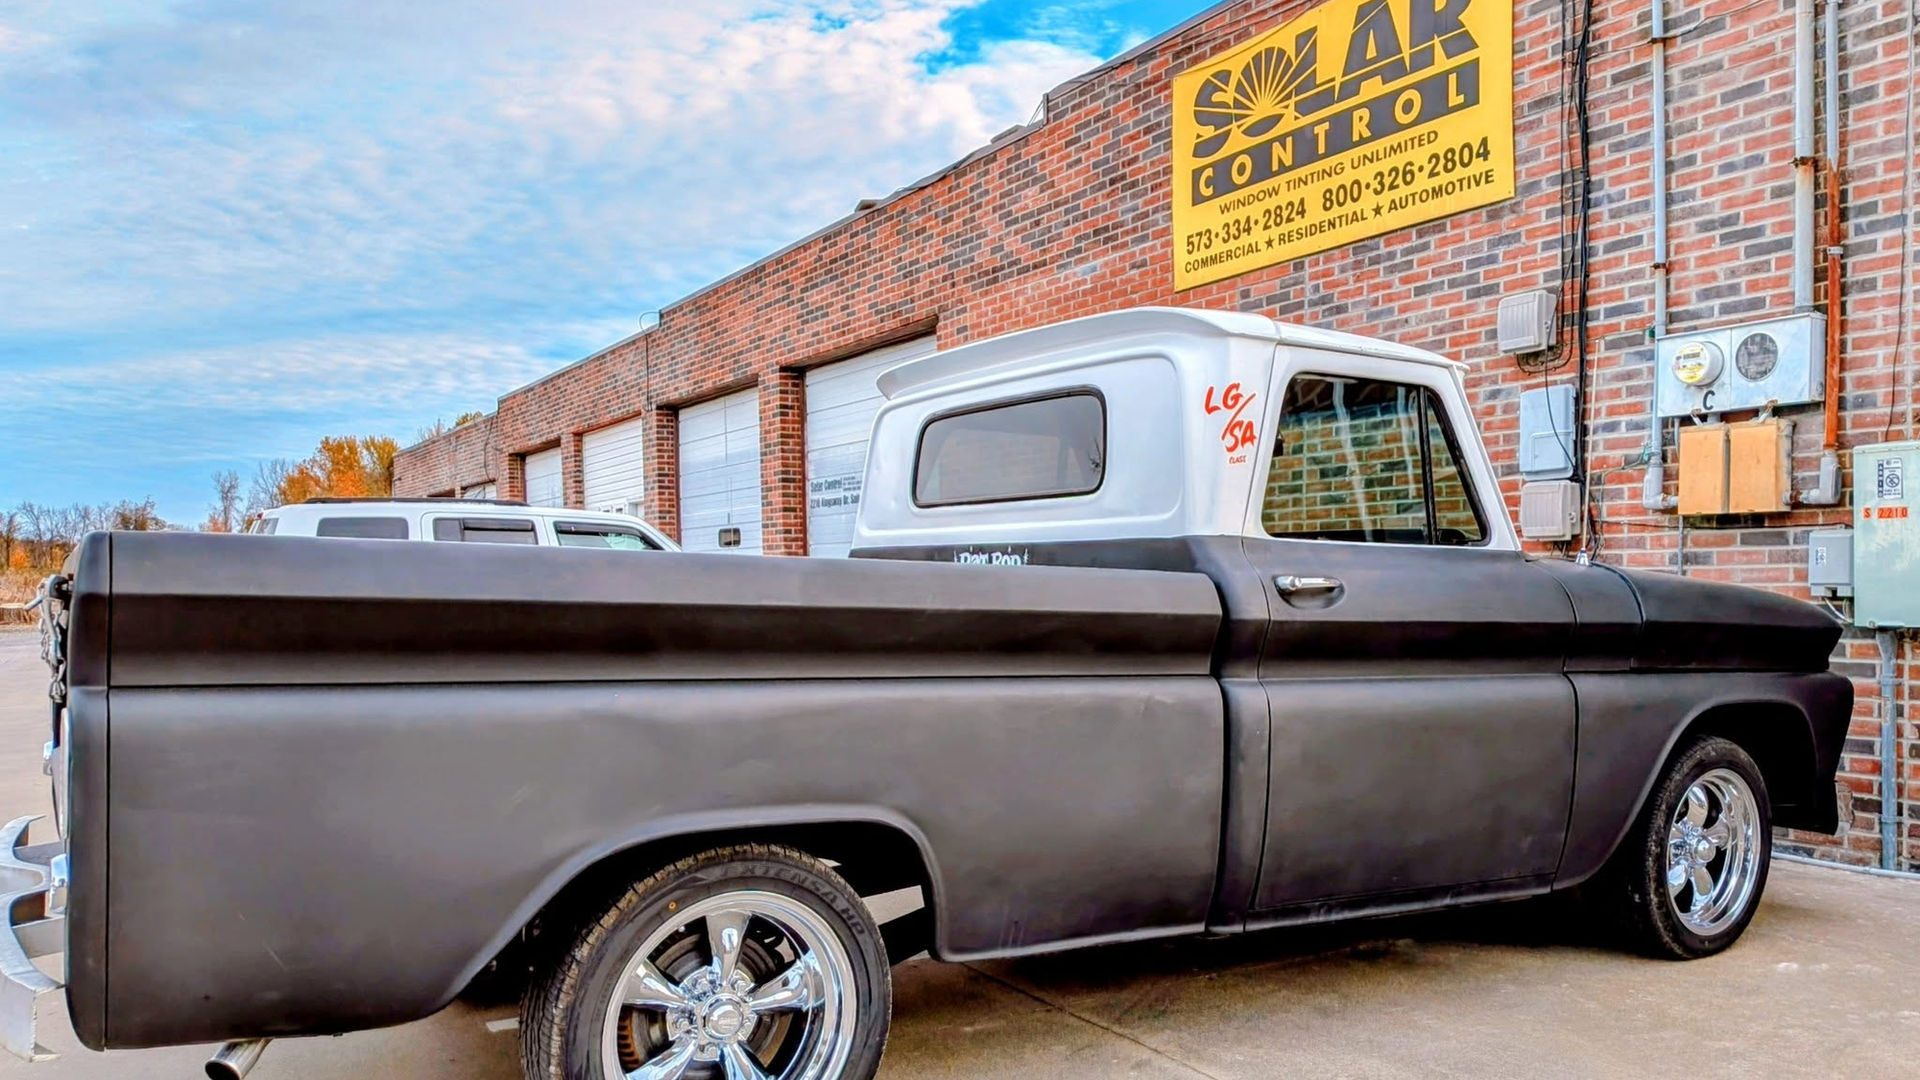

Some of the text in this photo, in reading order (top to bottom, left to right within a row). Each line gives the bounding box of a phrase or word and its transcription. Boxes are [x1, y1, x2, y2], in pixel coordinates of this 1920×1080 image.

[1192, 0, 1479, 158] SOLAR
[1199, 73, 1465, 198] CONTROL
[1219, 130, 1439, 215] WINDOW TINTING UNLIMITED
[1184, 169, 1496, 274] COMMERCIAL RESIDENTIAL AUTOMOTIVE
[1225, 419, 1257, 453] SA
[1702, 390, 1715, 410] C
[1879, 507, 1908, 518] 2210
